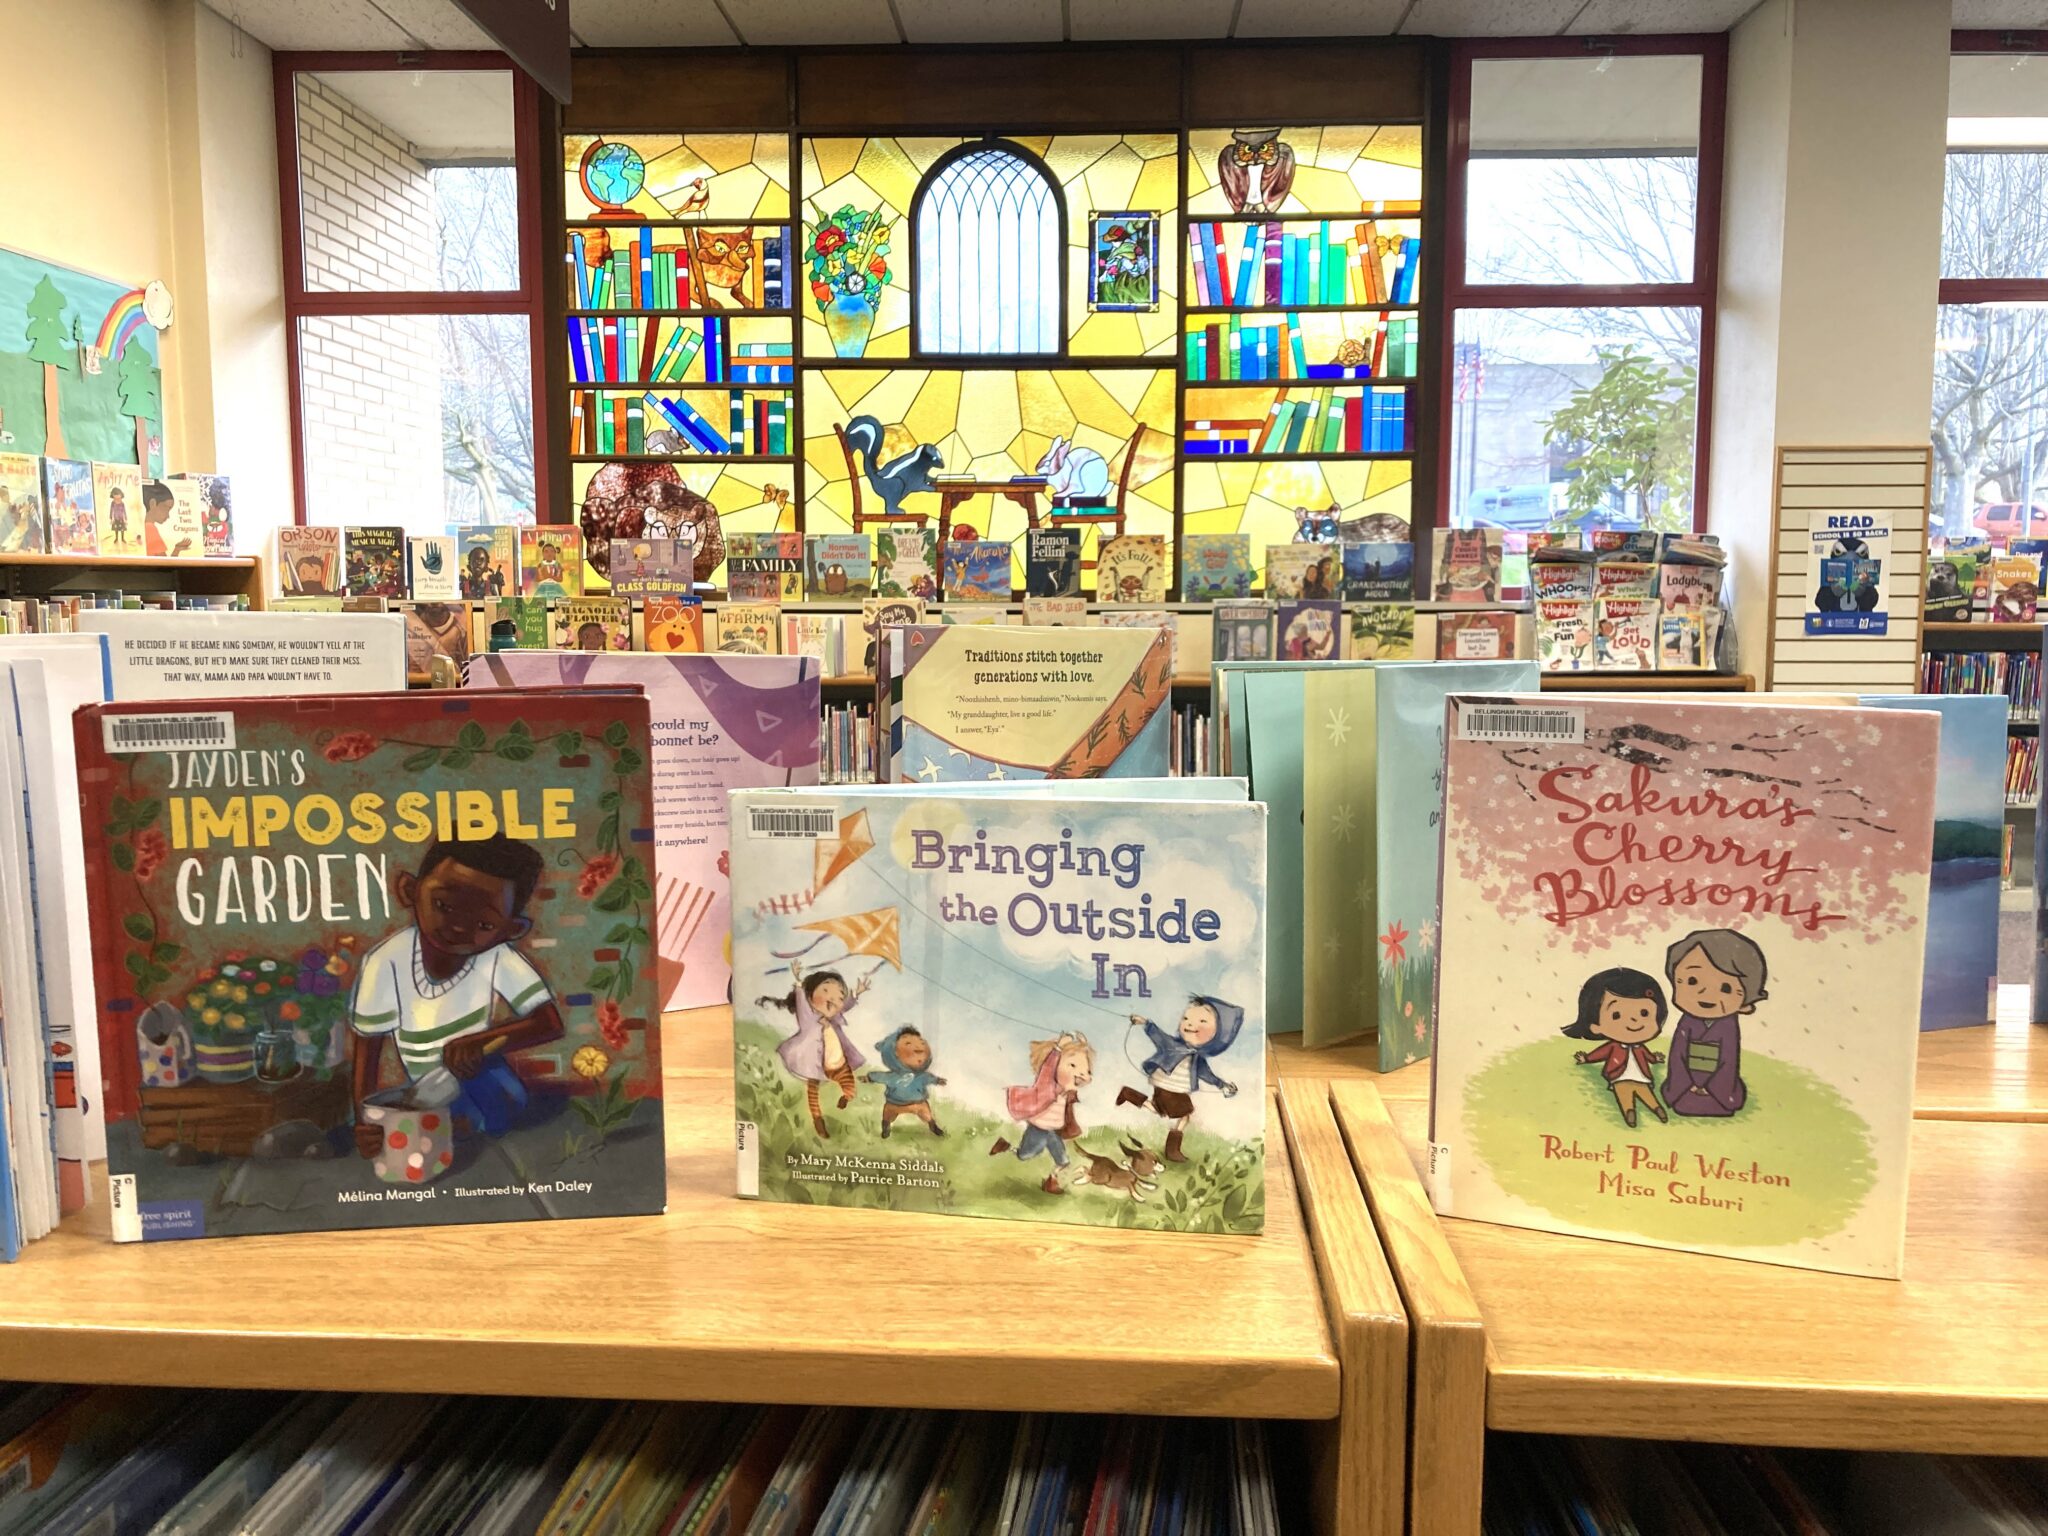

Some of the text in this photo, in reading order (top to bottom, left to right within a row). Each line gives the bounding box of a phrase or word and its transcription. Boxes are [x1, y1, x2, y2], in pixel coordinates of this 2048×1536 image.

[97, 471, 122, 489] Angry
[126, 475, 139, 486] Me
[173, 524, 199, 533] Crayons
[1828, 516, 1874, 528] READ
[281, 527, 337, 543] ORSON
[536, 531, 573, 546] Library
[1032, 534, 1069, 546] Ramon
[377, 538, 395, 546] NIGHT
[828, 543, 859, 551] Norman
[495, 547, 509, 560] UP
[821, 551, 844, 560] Didn't
[857, 552, 867, 560] It!
[1032, 546, 1066, 557] Fellini
[1111, 550, 1152, 565] It's Fall!
[742, 559, 799, 572] FAMILY
[1997, 569, 2032, 579] Snakes
[616, 582, 687, 592] CLASS GOLDFISH
[1047, 602, 1084, 612] BAD SEED
[525, 616, 542, 624] you
[651, 606, 696, 623] ZOO
[726, 612, 764, 624] FARM
[880, 607, 907, 622] Say My
[1362, 609, 1406, 627] AVOCADO
[525, 625, 542, 633] hug
[1556, 619, 1583, 629] Fresh
[1624, 626, 1639, 635] get
[1554, 632, 1575, 641] Fun
[1612, 635, 1651, 649] LOUD
[124, 640, 365, 650] HE DECIDED IF HE BECAME KING SOMEDAY, HE WOULDN'T YELL AT THE
[129, 656, 362, 667] LITTLE DRAGONS, BUT HE'D MAKE SURE THEY CLEANED THEIR MESS.
[965, 649, 1103, 666] Traditions stitch together
[163, 671, 333, 682] THAT WAY, MAMA AND PAPA WOULDN'T HAVE TO.
[974, 670, 1095, 685] generations with love.
[947, 710, 961, 719] "My
[963, 711, 1009, 720] granddaughter,
[1010, 710, 1021, 718] live
[1026, 710, 1042, 719] good
[651, 719, 709, 732] could my
[651, 734, 719, 746] bonnet be?
[166, 750, 306, 789] JAYDEN'S
[1538, 764, 1815, 828] Sakura's
[169, 788, 577, 850] IMPOSSIBLE
[664, 836, 708, 847] anywhere!
[911, 828, 1145, 889] Bringing
[1572, 821, 1818, 886] Cherry
[176, 853, 391, 926] GARDEN
[1533, 865, 1845, 931] Blossoms
[940, 893, 1221, 944] the Outside
[1091, 953, 1152, 999] In
[787, 1154, 944, 1173] By Mary McKenna Siddals
[1430, 1146, 1438, 1175] Picture
[1539, 1134, 1791, 1188] Robert Paul Weston
[792, 1170, 940, 1188] Illustrated by Patrice Barton
[113, 1179, 121, 1208] Picture
[338, 1180, 593, 1203] Mélina Mangal Illustrated by Ken Daley
[1597, 1170, 1744, 1212] Misa Saburi
[163, 1210, 191, 1221] spirit
